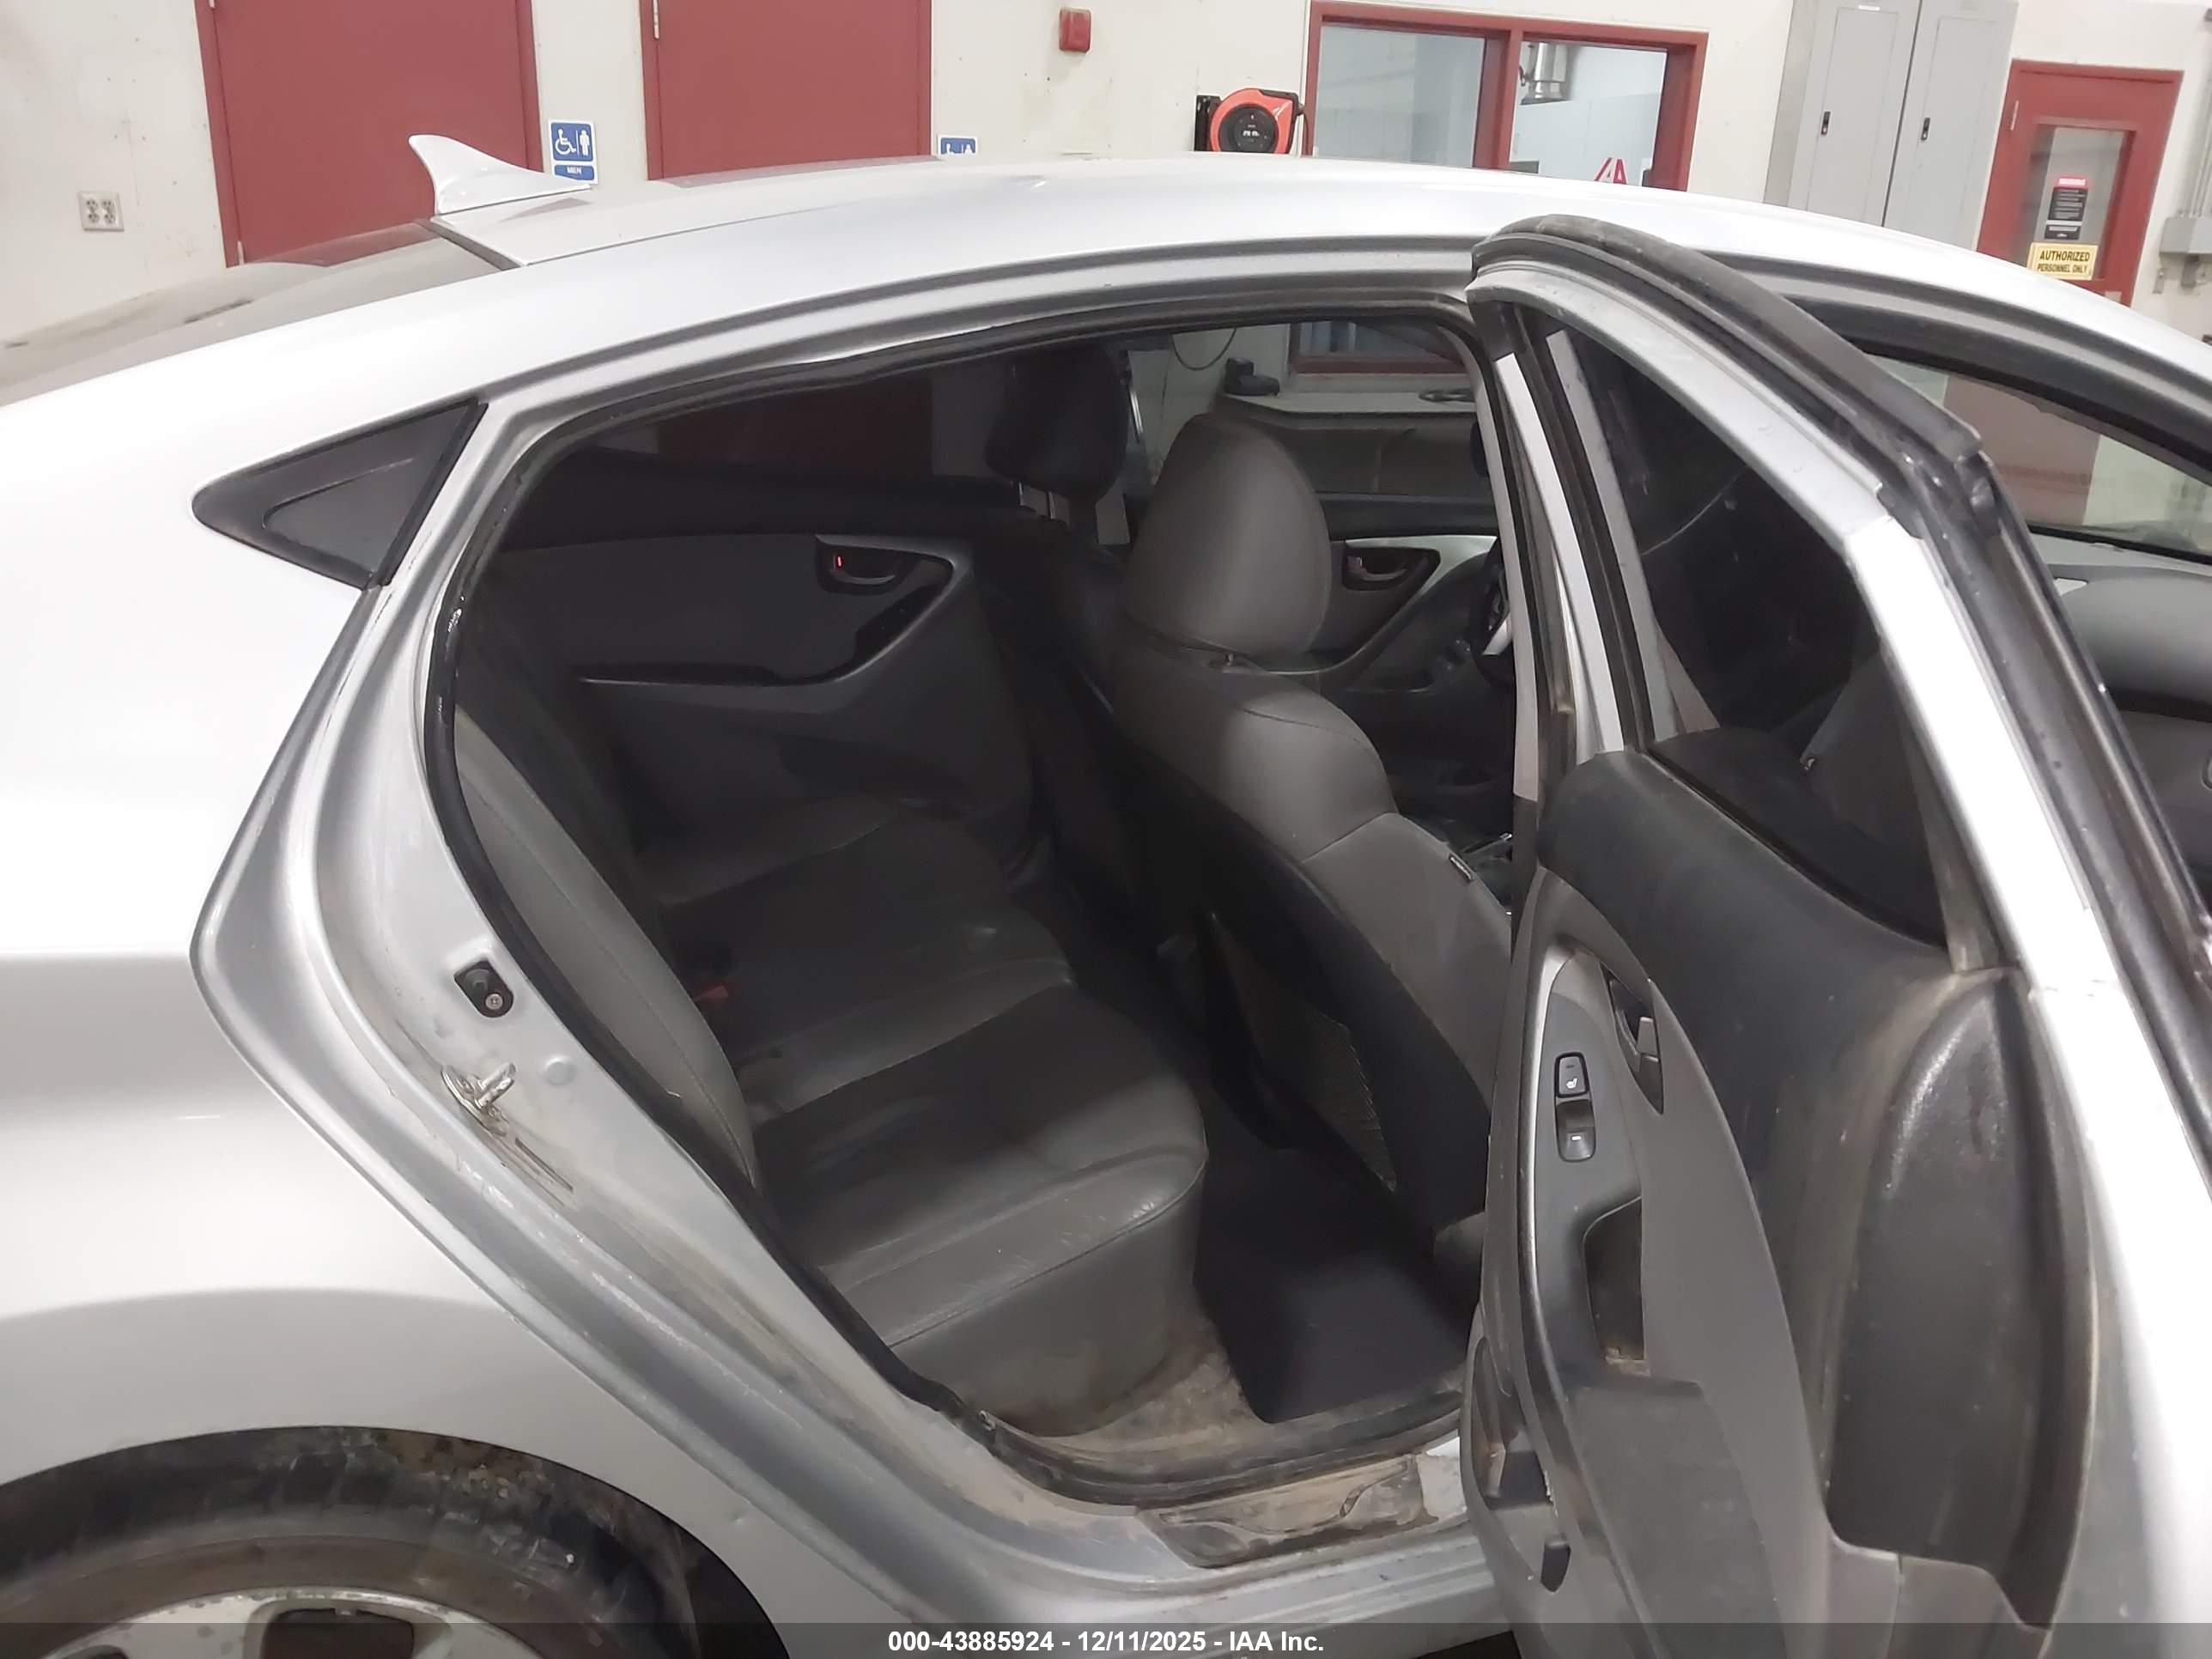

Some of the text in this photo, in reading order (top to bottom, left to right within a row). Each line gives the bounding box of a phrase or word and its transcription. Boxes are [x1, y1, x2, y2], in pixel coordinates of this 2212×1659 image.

[2039, 250, 2091, 262] AUTHORIZED
[2037, 263, 2088, 274] PERSONNEL ONLY
